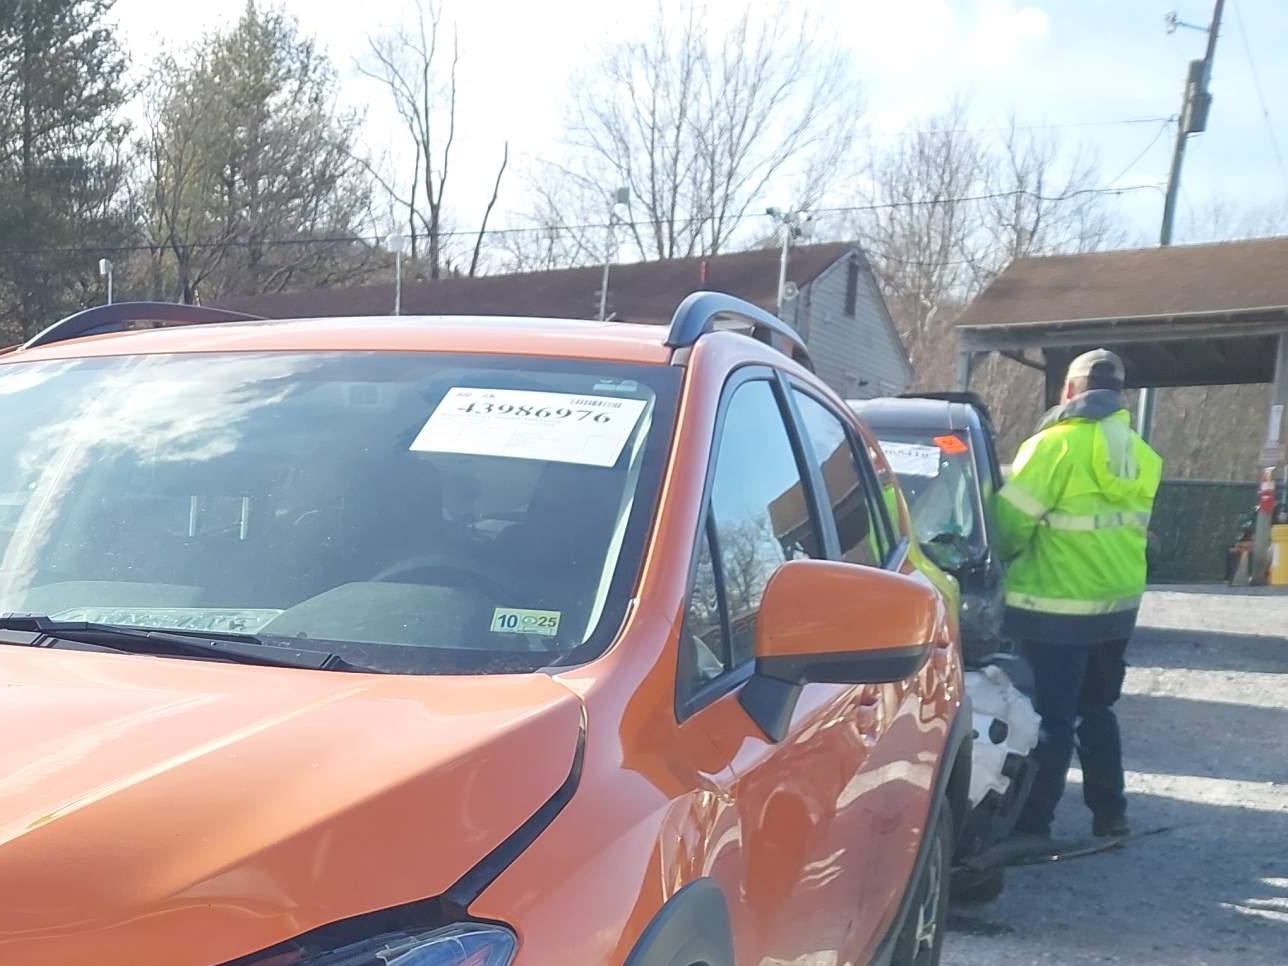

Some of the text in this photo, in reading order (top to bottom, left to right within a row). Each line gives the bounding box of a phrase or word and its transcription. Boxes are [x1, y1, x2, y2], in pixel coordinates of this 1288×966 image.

[457, 402, 612, 424] 43986976
[498, 614, 557, 628] 10 25
